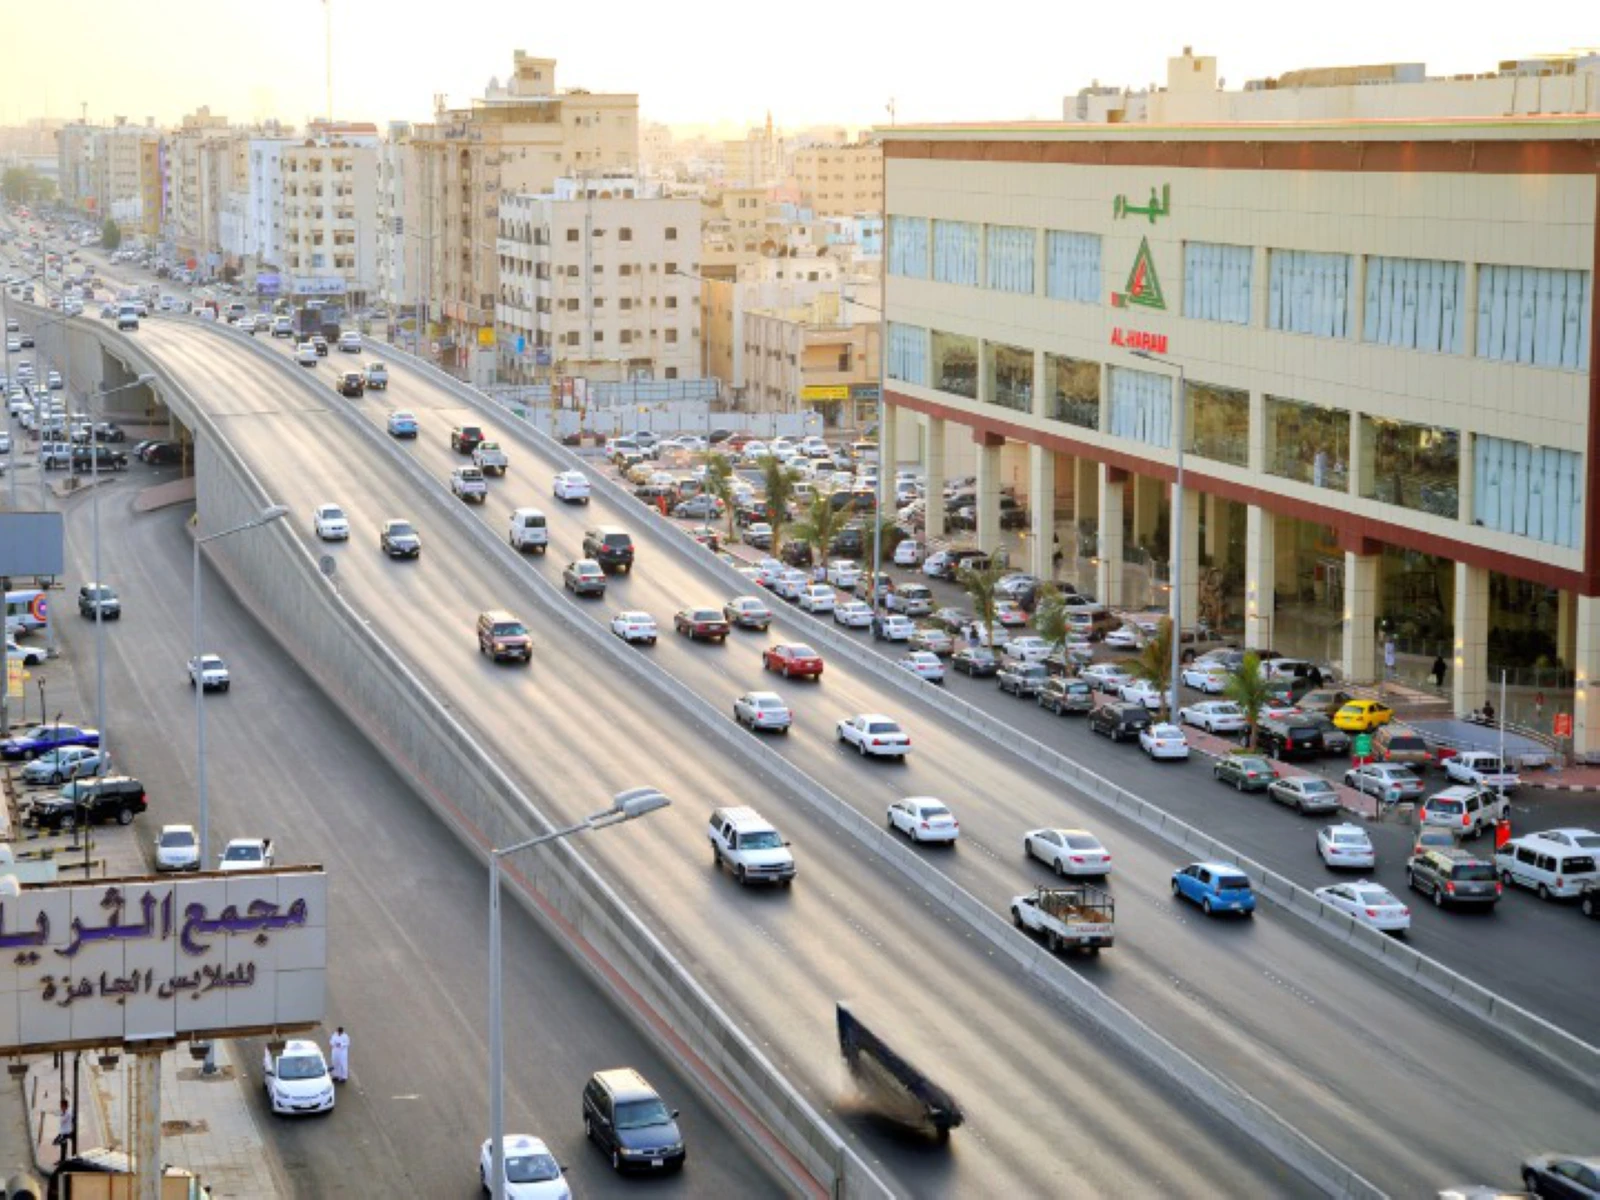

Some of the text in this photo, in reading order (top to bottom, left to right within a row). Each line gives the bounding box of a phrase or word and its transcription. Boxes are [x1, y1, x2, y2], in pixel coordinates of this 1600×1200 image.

[180, 898, 308, 956] مجمع
[40, 961, 256, 1008] للملابس الجاهزة
